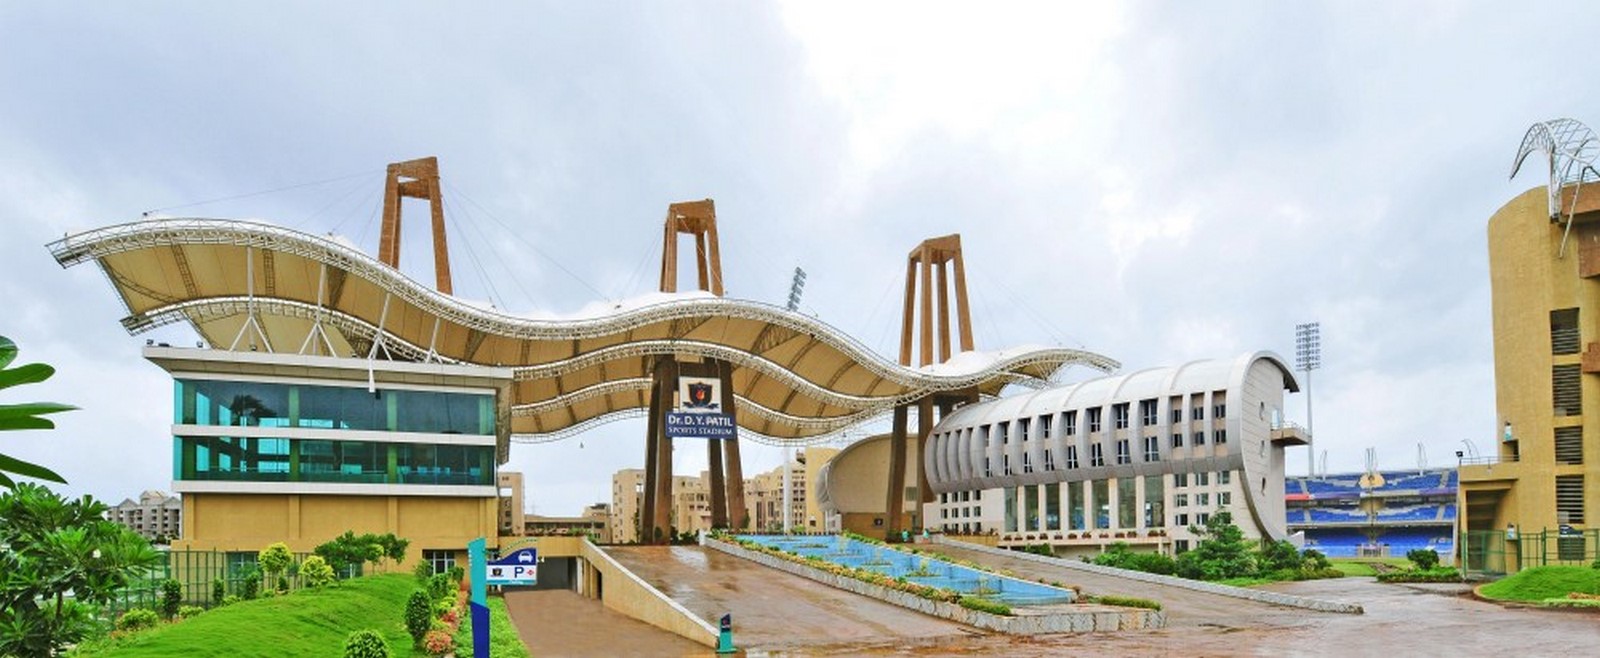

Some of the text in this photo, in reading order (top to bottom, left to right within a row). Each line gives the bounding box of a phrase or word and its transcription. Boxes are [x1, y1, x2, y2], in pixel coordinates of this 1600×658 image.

[706, 416, 733, 427] PATIL
[668, 426, 732, 435] SPORTS STADIUM
[514, 566, 524, 578] P
